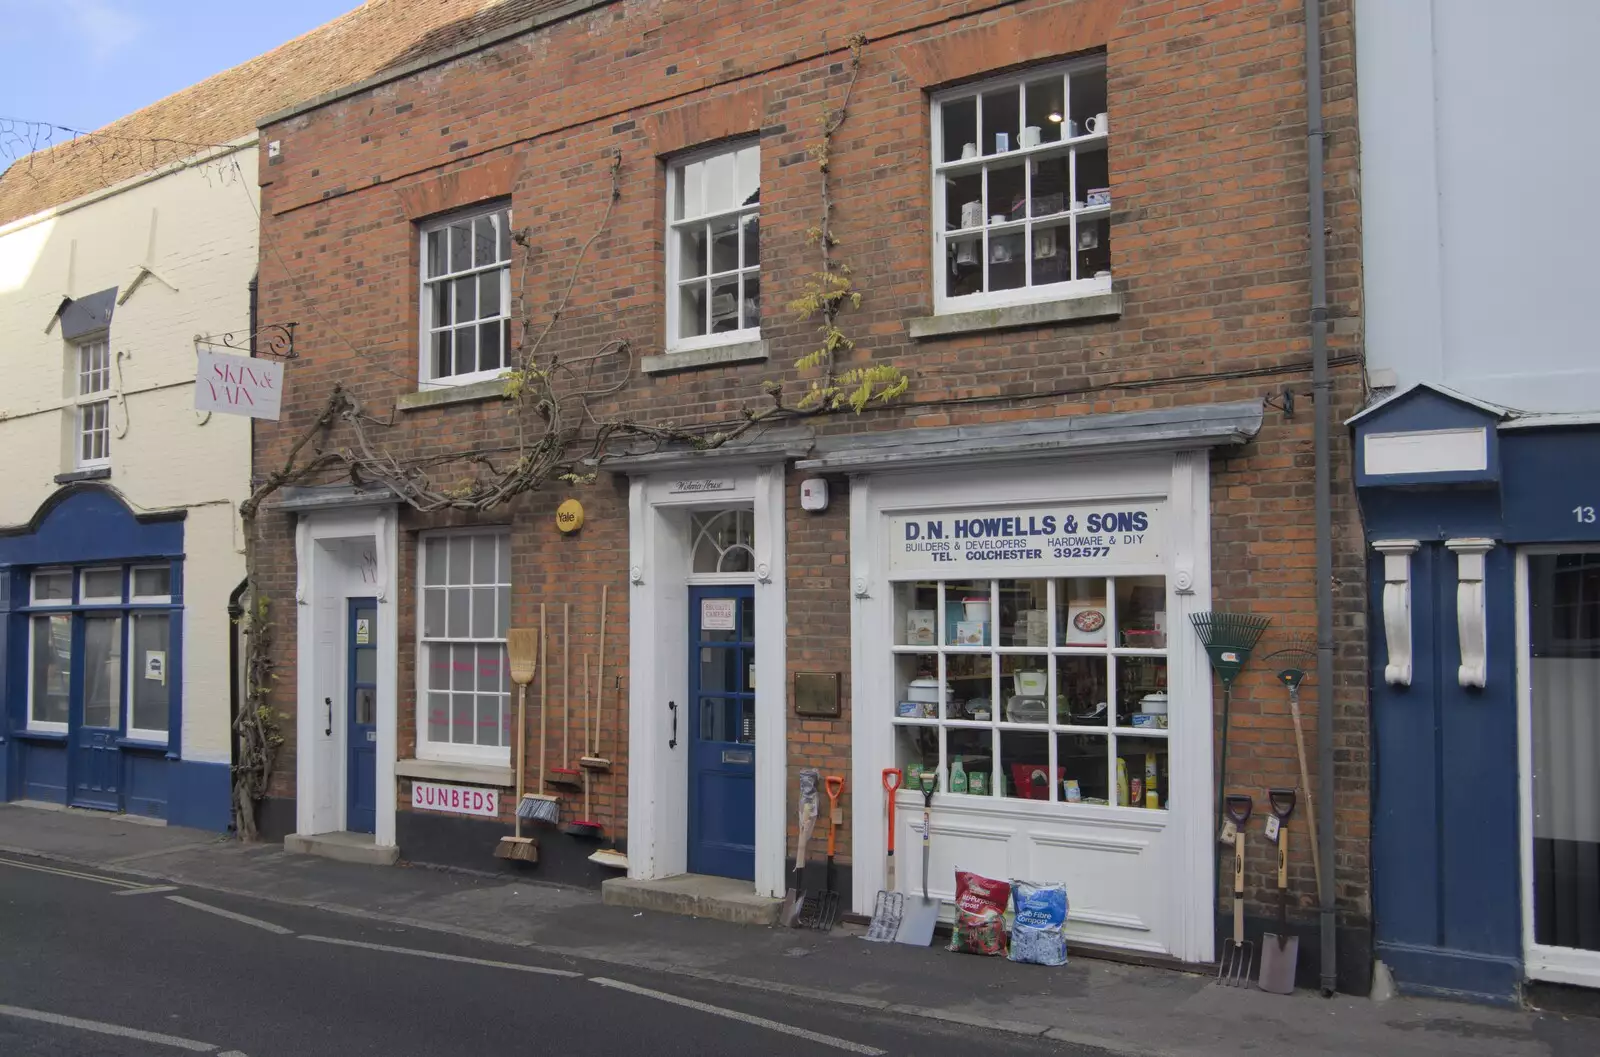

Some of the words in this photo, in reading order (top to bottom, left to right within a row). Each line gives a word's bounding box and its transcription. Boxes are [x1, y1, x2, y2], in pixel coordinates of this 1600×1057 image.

[213, 364, 258, 387] SKIN
[260, 371, 275, 389] &
[204, 377, 254, 405] VAIN
[557, 511, 576, 522] Yale
[1571, 505, 1596, 523] 13
[905, 520, 949, 541] D.N.
[954, 515, 1057, 539] HOWELLS
[1063, 514, 1079, 534] &
[1086, 511, 1149, 533] SONS
[905, 541, 950, 552] BUILDERS
[954, 541, 961, 551] &
[965, 538, 1027, 550] DEVELOPERS
[1047, 535, 1103, 547] HARDWARE
[1108, 535, 1117, 545] &
[1123, 534, 1145, 545] DIY
[931, 551, 957, 562] TEL.
[965, 548, 1043, 561] COLCHESTER
[1053, 546, 1110, 558] 392577
[416, 785, 494, 812] SUNBEDS
[1017, 914, 1048, 925] Compost
[1033, 911, 1052, 920] Fibre
